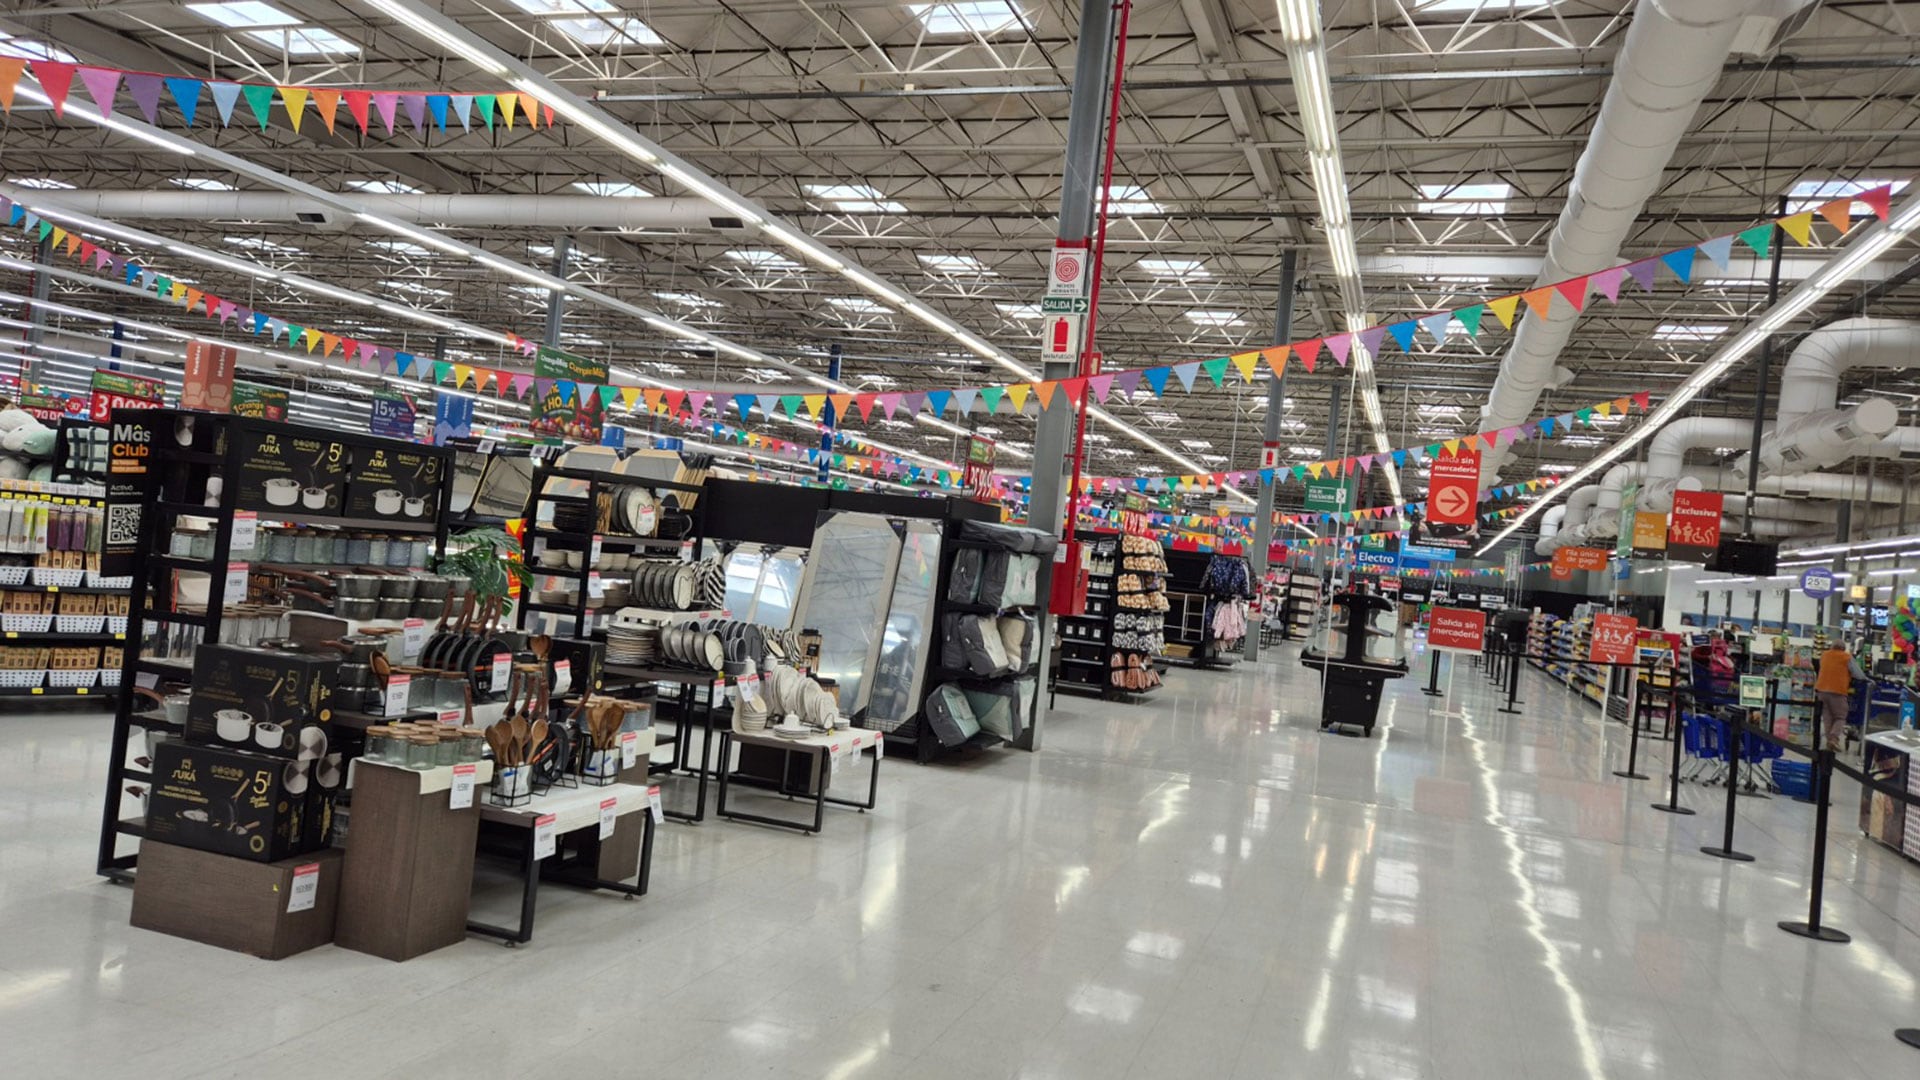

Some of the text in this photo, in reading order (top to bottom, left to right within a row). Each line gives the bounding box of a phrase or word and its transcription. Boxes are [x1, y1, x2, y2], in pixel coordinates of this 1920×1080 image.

[1044, 300, 1070, 309] SALIDA
[374, 400, 397, 418] 15%
[548, 396, 575, 410] HOA
[112, 444, 149, 457] Club
[1461, 456, 1475, 465] sin
[1434, 465, 1477, 473] mercadería
[1676, 497, 1690, 506] Fila
[1675, 506, 1718, 517] Exclusiva
[1358, 552, 1394, 564] Electro
[1437, 617, 1478, 629] Salida sin
[1432, 627, 1480, 640] mercadería
[253, 771, 268, 794] 5
